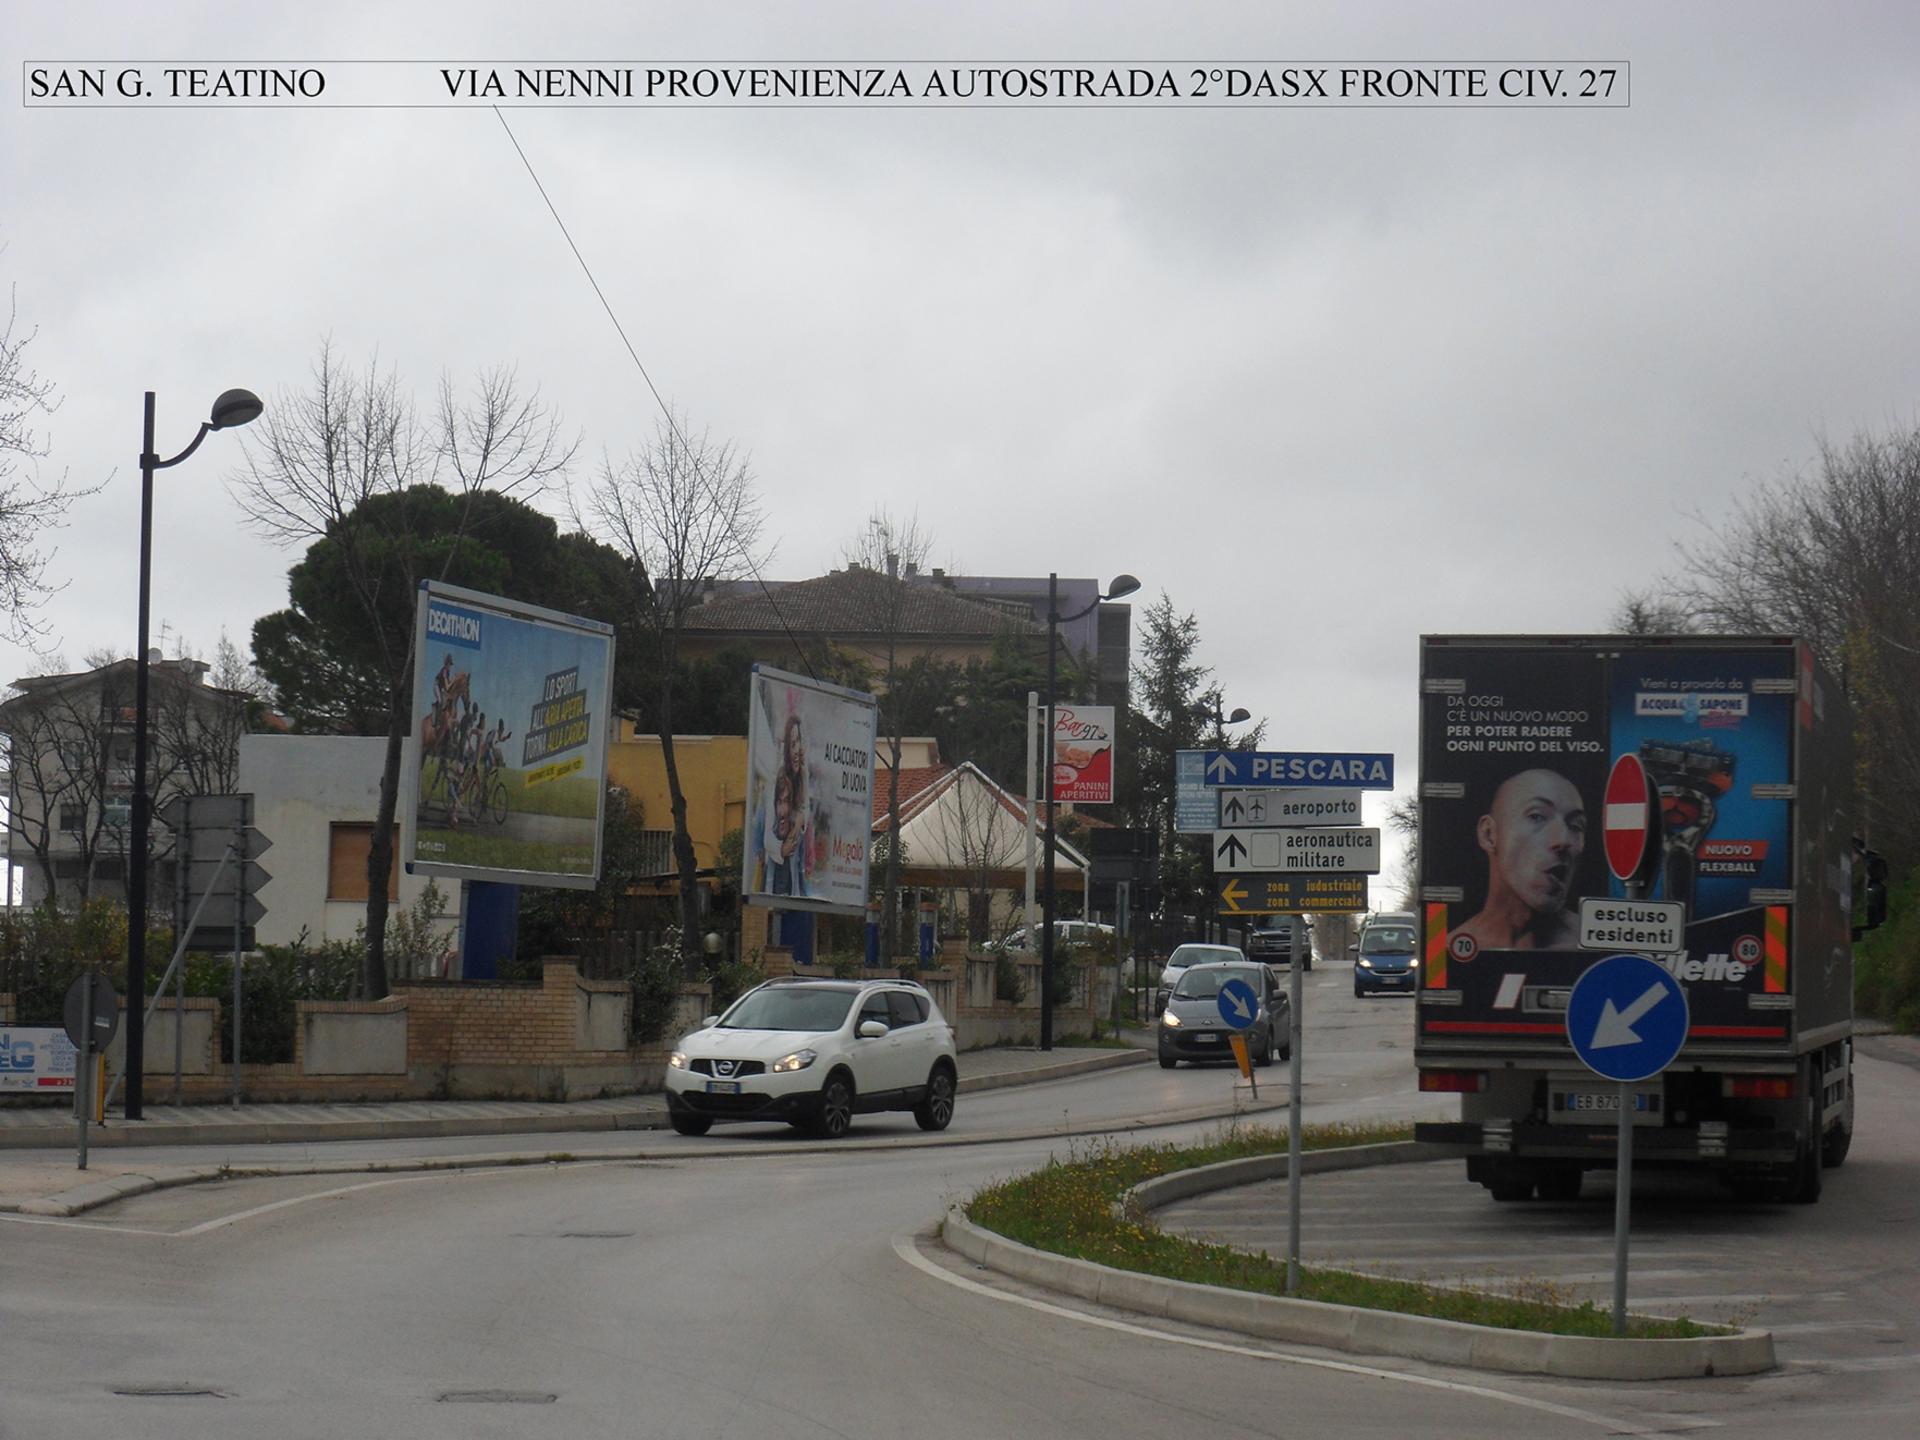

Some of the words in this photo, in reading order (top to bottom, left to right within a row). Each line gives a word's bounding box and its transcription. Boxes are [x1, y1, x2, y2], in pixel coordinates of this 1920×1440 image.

[428, 608, 480, 642] DECATHLON
[1640, 678, 1668, 690] Vieni
[1681, 678, 1725, 691] provarlo
[1728, 678, 1743, 689] da
[1447, 695, 1465, 707] DA
[1468, 695, 1503, 707] OGGI
[1641, 699, 1675, 711] ACQUA
[1699, 698, 1743, 710] SAPONE
[1446, 708, 1466, 722] C'È
[1470, 710, 1488, 722] UN
[1493, 711, 1542, 722] NUOVO
[1545, 711, 1588, 722] MODO
[1054, 708, 1083, 737] Bar
[1082, 724, 1099, 740] 97
[1447, 725, 1471, 737] PER
[1475, 726, 1517, 737] POTER
[1522, 726, 1572, 737] RADERE
[1446, 740, 1484, 752] OGNI
[1488, 741, 1536, 752] PUNTO
[1540, 742, 1563, 752] DEL
[1567, 742, 1604, 753] VISO.
[833, 744, 868, 769] CACCIATORI
[1253, 758, 1388, 781] PESCARA
[842, 771, 849, 790] DI
[850, 773, 867, 793] UOVA
[1074, 782, 1109, 791] PANINI
[1059, 791, 1109, 800] APERITIVI
[1283, 799, 1357, 816] aeroporto
[1287, 830, 1373, 848] aeronautica
[1705, 844, 1752, 856] NUOVO
[1287, 850, 1345, 868] militare
[1699, 862, 1756, 873] FLEXBALL
[1267, 881, 1290, 892] zona
[1267, 897, 1290, 907] zona
[1299, 894, 1363, 907] commerciale
[1594, 906, 1668, 924] escluso
[1587, 927, 1674, 945] residenti
[1457, 940, 1472, 953] 70
[1740, 943, 1757, 956] 80
